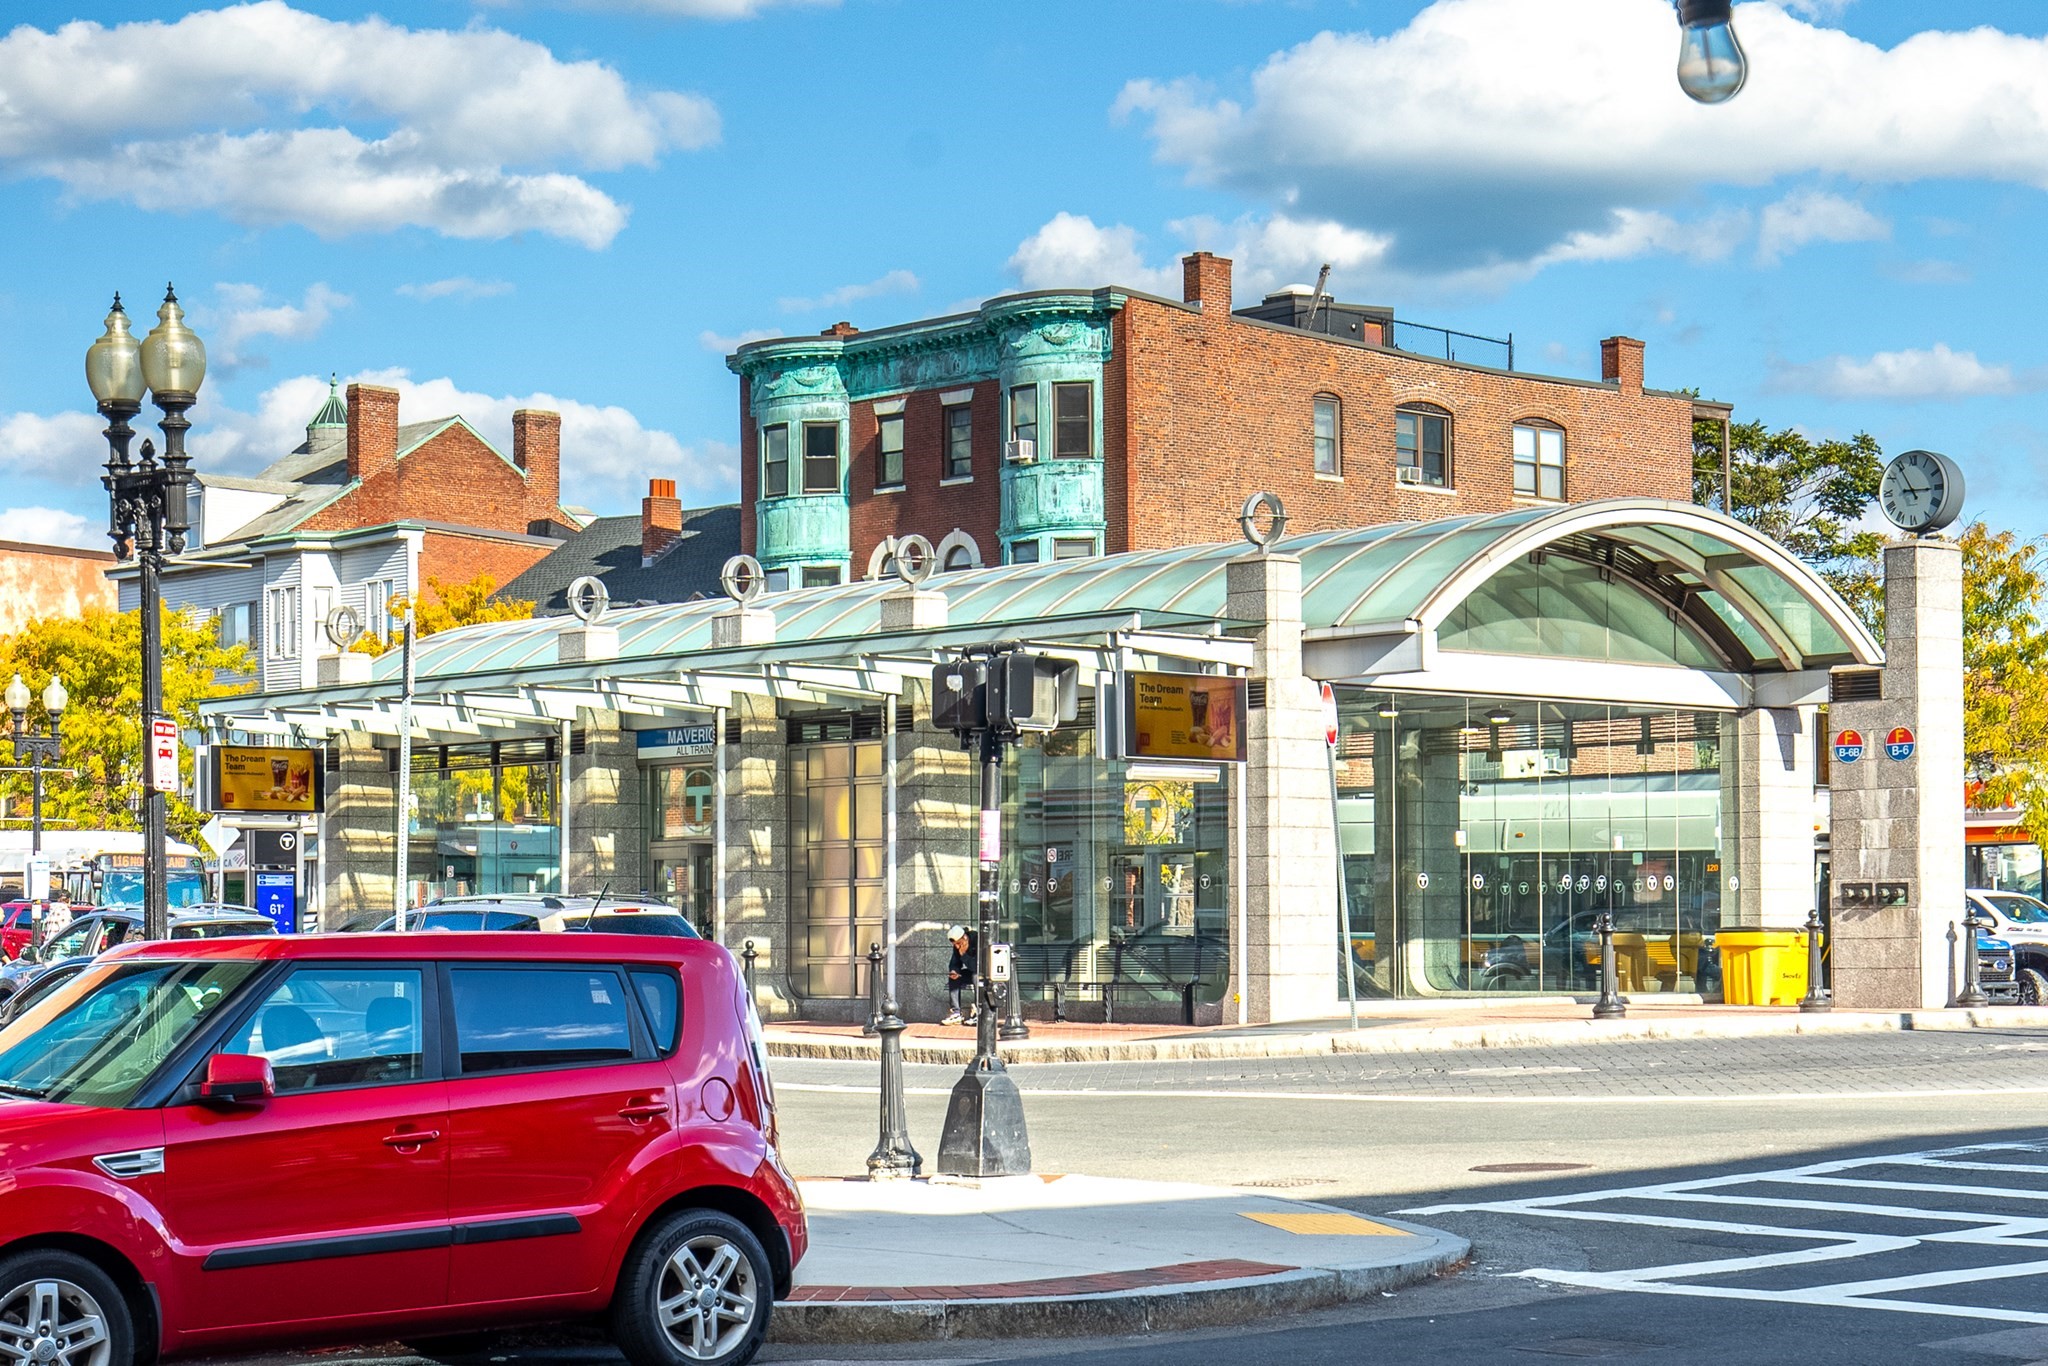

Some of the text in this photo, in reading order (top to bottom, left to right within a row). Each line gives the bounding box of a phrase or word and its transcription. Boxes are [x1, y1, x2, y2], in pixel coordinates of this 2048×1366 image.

[1139, 682, 1184, 694] The Dream
[1139, 694, 1162, 704] Team
[667, 728, 714, 744] MAVERIC
[1844, 731, 1853, 745] F
[1895, 729, 1904, 743] F
[676, 746, 689, 755] ALL
[1839, 748, 1860, 757] B-6B
[1891, 745, 1909, 756] B-6
[225, 754, 266, 763] The Dream
[225, 762, 246, 771] Team
[112, 854, 187, 869] 116 WOLAND
[204, 858, 232, 868] MERCA
[1706, 864, 1719, 872] 120
[269, 903, 285, 915] 61°
